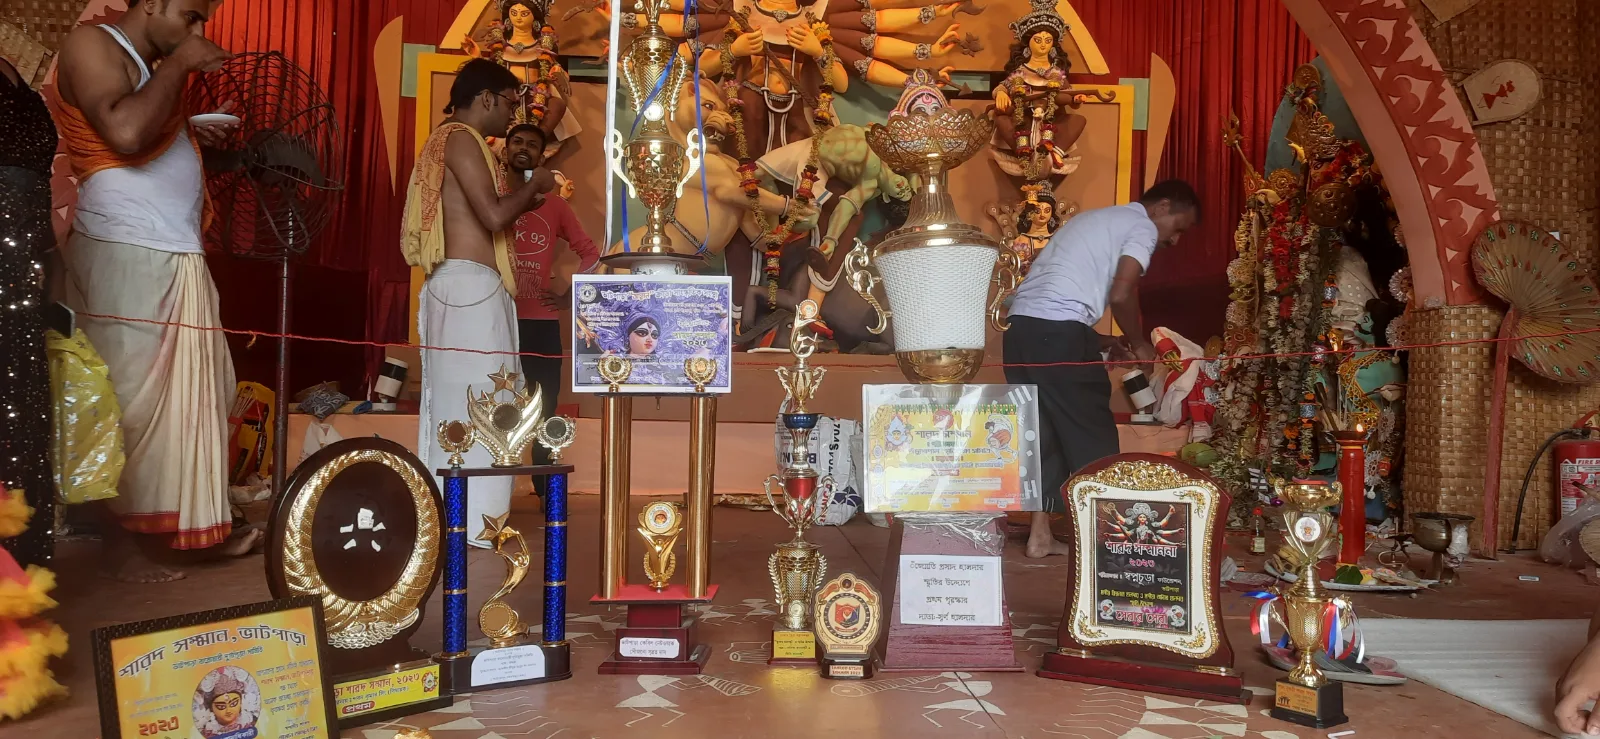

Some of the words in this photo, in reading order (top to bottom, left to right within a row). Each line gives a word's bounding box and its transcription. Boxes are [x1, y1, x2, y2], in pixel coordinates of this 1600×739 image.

[530, 232, 546, 246] 92
[1105, 541, 1133, 555] শারদ
[1133, 541, 1178, 558] সম্মাননা
[926, 596, 942, 604] প্রথম
[118, 646, 166, 679] শারদ
[237, 624, 308, 648] ভাটপাড়া
[346, 682, 367, 694] শারদ
[397, 673, 420, 685] ২০২৩
[345, 702, 371, 713] প্রথম
[138, 715, 180, 737] ২০২৩
